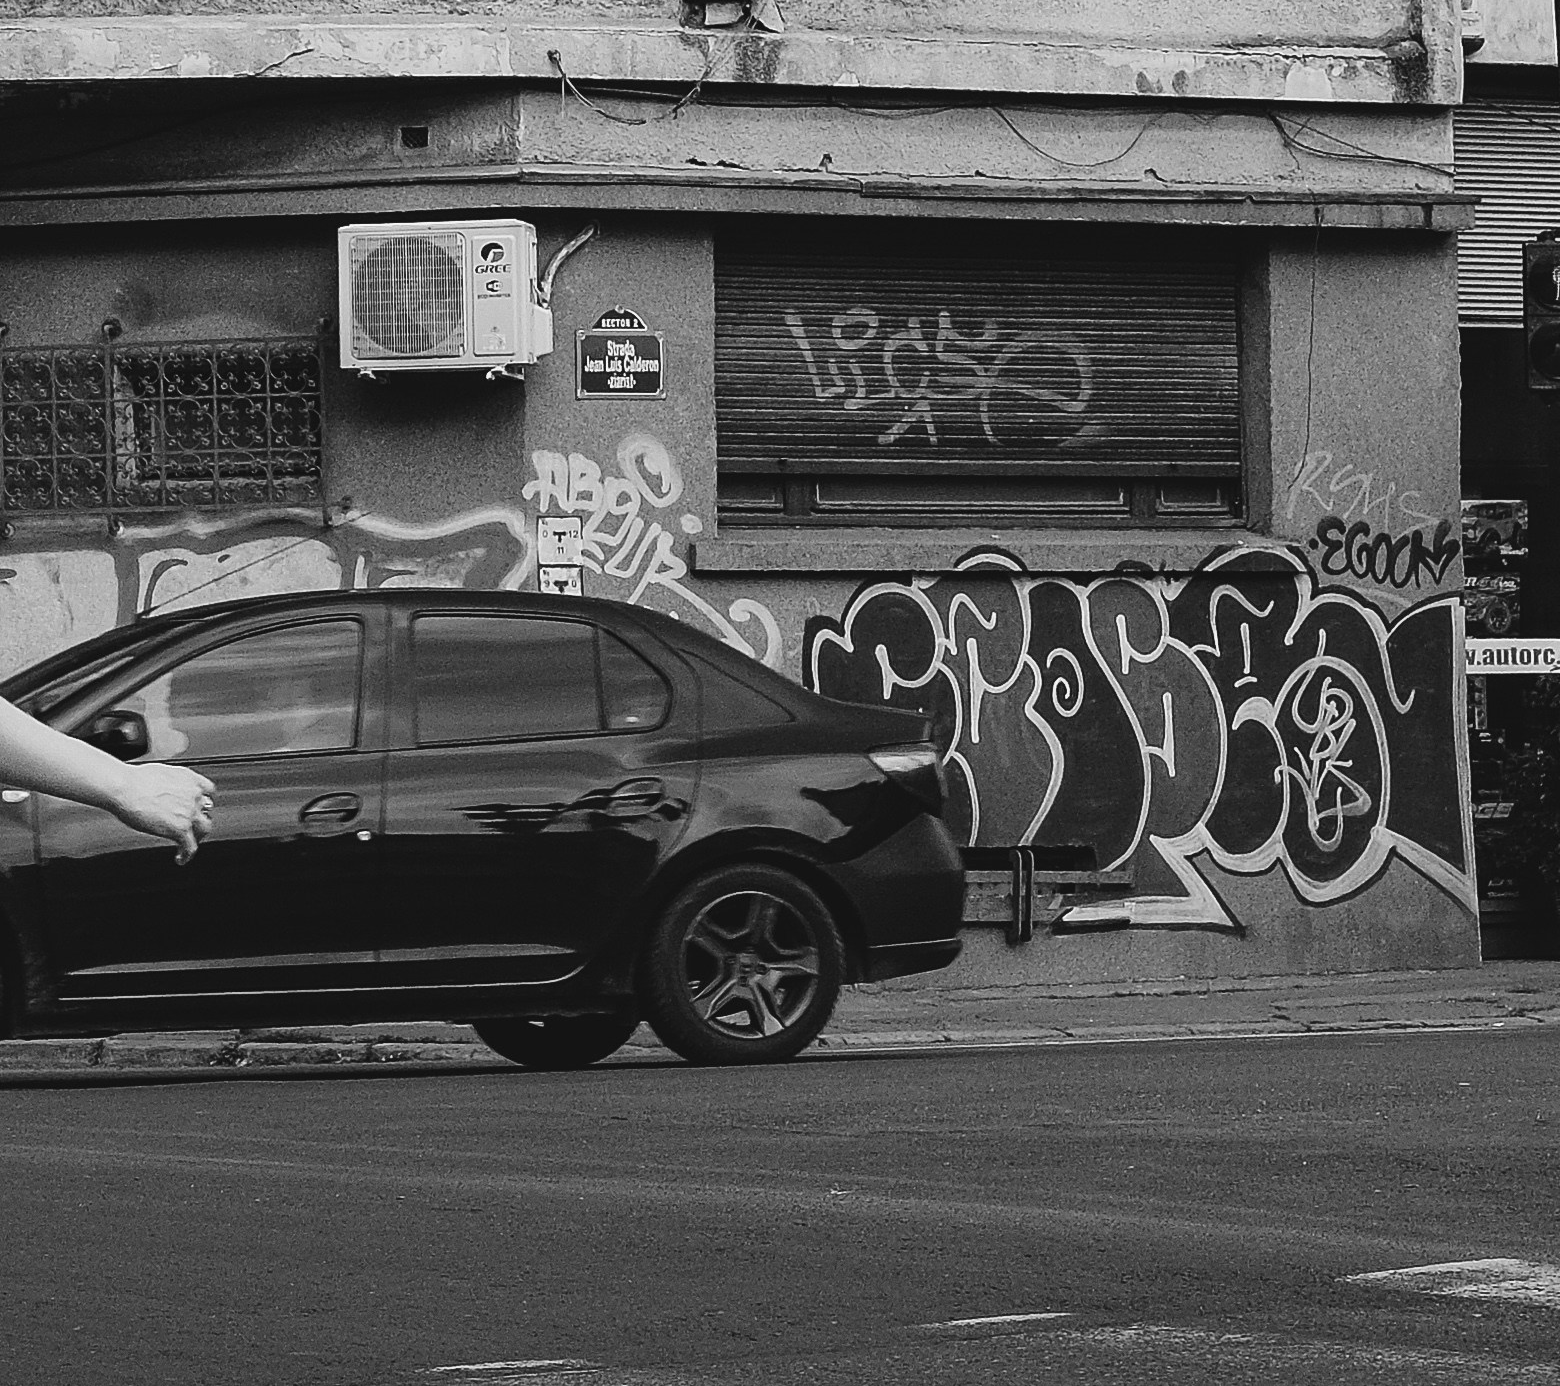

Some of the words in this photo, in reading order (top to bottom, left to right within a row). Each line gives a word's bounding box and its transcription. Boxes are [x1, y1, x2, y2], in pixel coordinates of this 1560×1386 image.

[475, 264, 511, 274] GREE
[607, 340, 635, 356] Strada
[584, 356, 604, 372] Jean
[605, 356, 622, 372] Luis
[623, 356, 659, 373] Calderon
[568, 530, 578, 538] 12
[557, 546, 564, 554] 11
